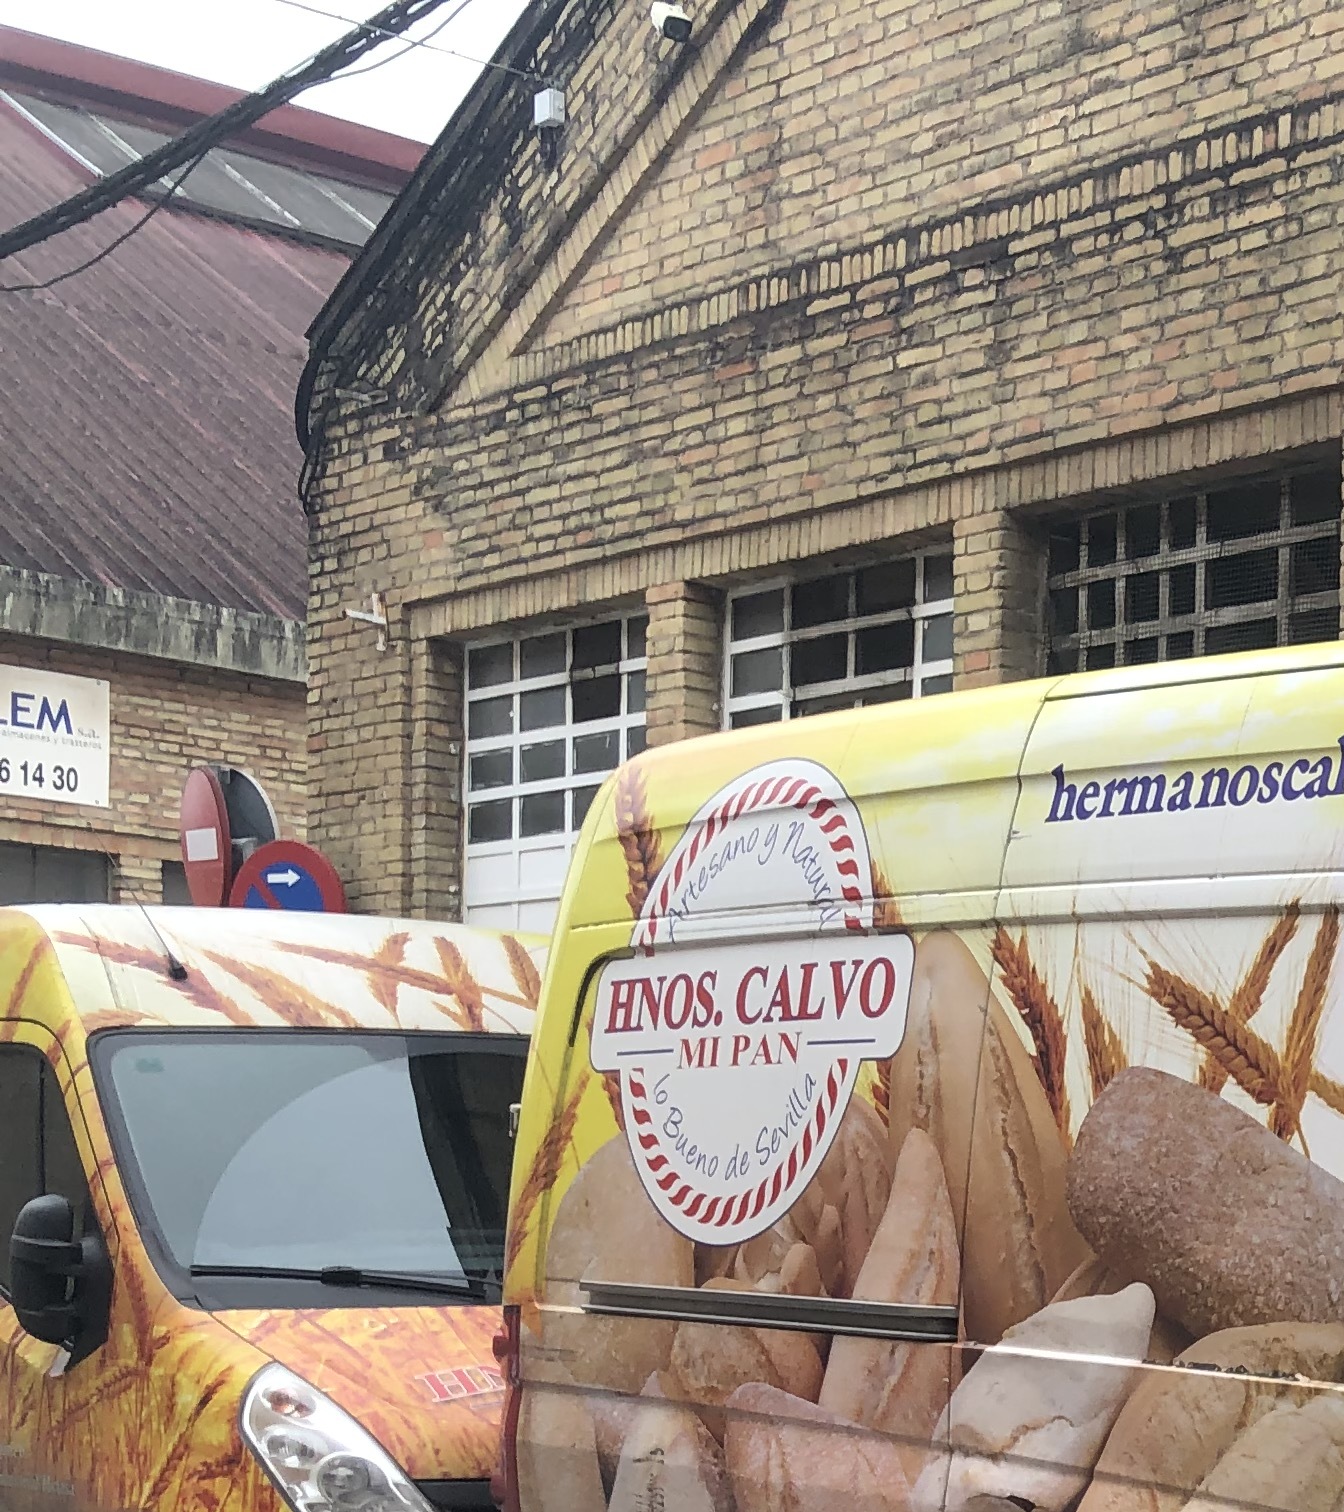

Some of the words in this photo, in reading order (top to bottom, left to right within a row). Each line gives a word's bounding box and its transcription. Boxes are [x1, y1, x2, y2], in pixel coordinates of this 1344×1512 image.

[0, 691, 73, 735] EM
[20, 761, 44, 788] 14
[52, 765, 78, 793] 30
[669, 828, 759, 944] Artesano
[758, 823, 779, 865] y
[782, 821, 842, 932] Natural
[604, 970, 723, 1033] HNOS.
[736, 957, 895, 1025] CALVO
[677, 1036, 722, 1069] MI
[729, 1032, 802, 1067] PAN
[663, 1107, 718, 1177] Bueno
[725, 1143, 749, 1181] de
[756, 1073, 816, 1166] Sevilla
